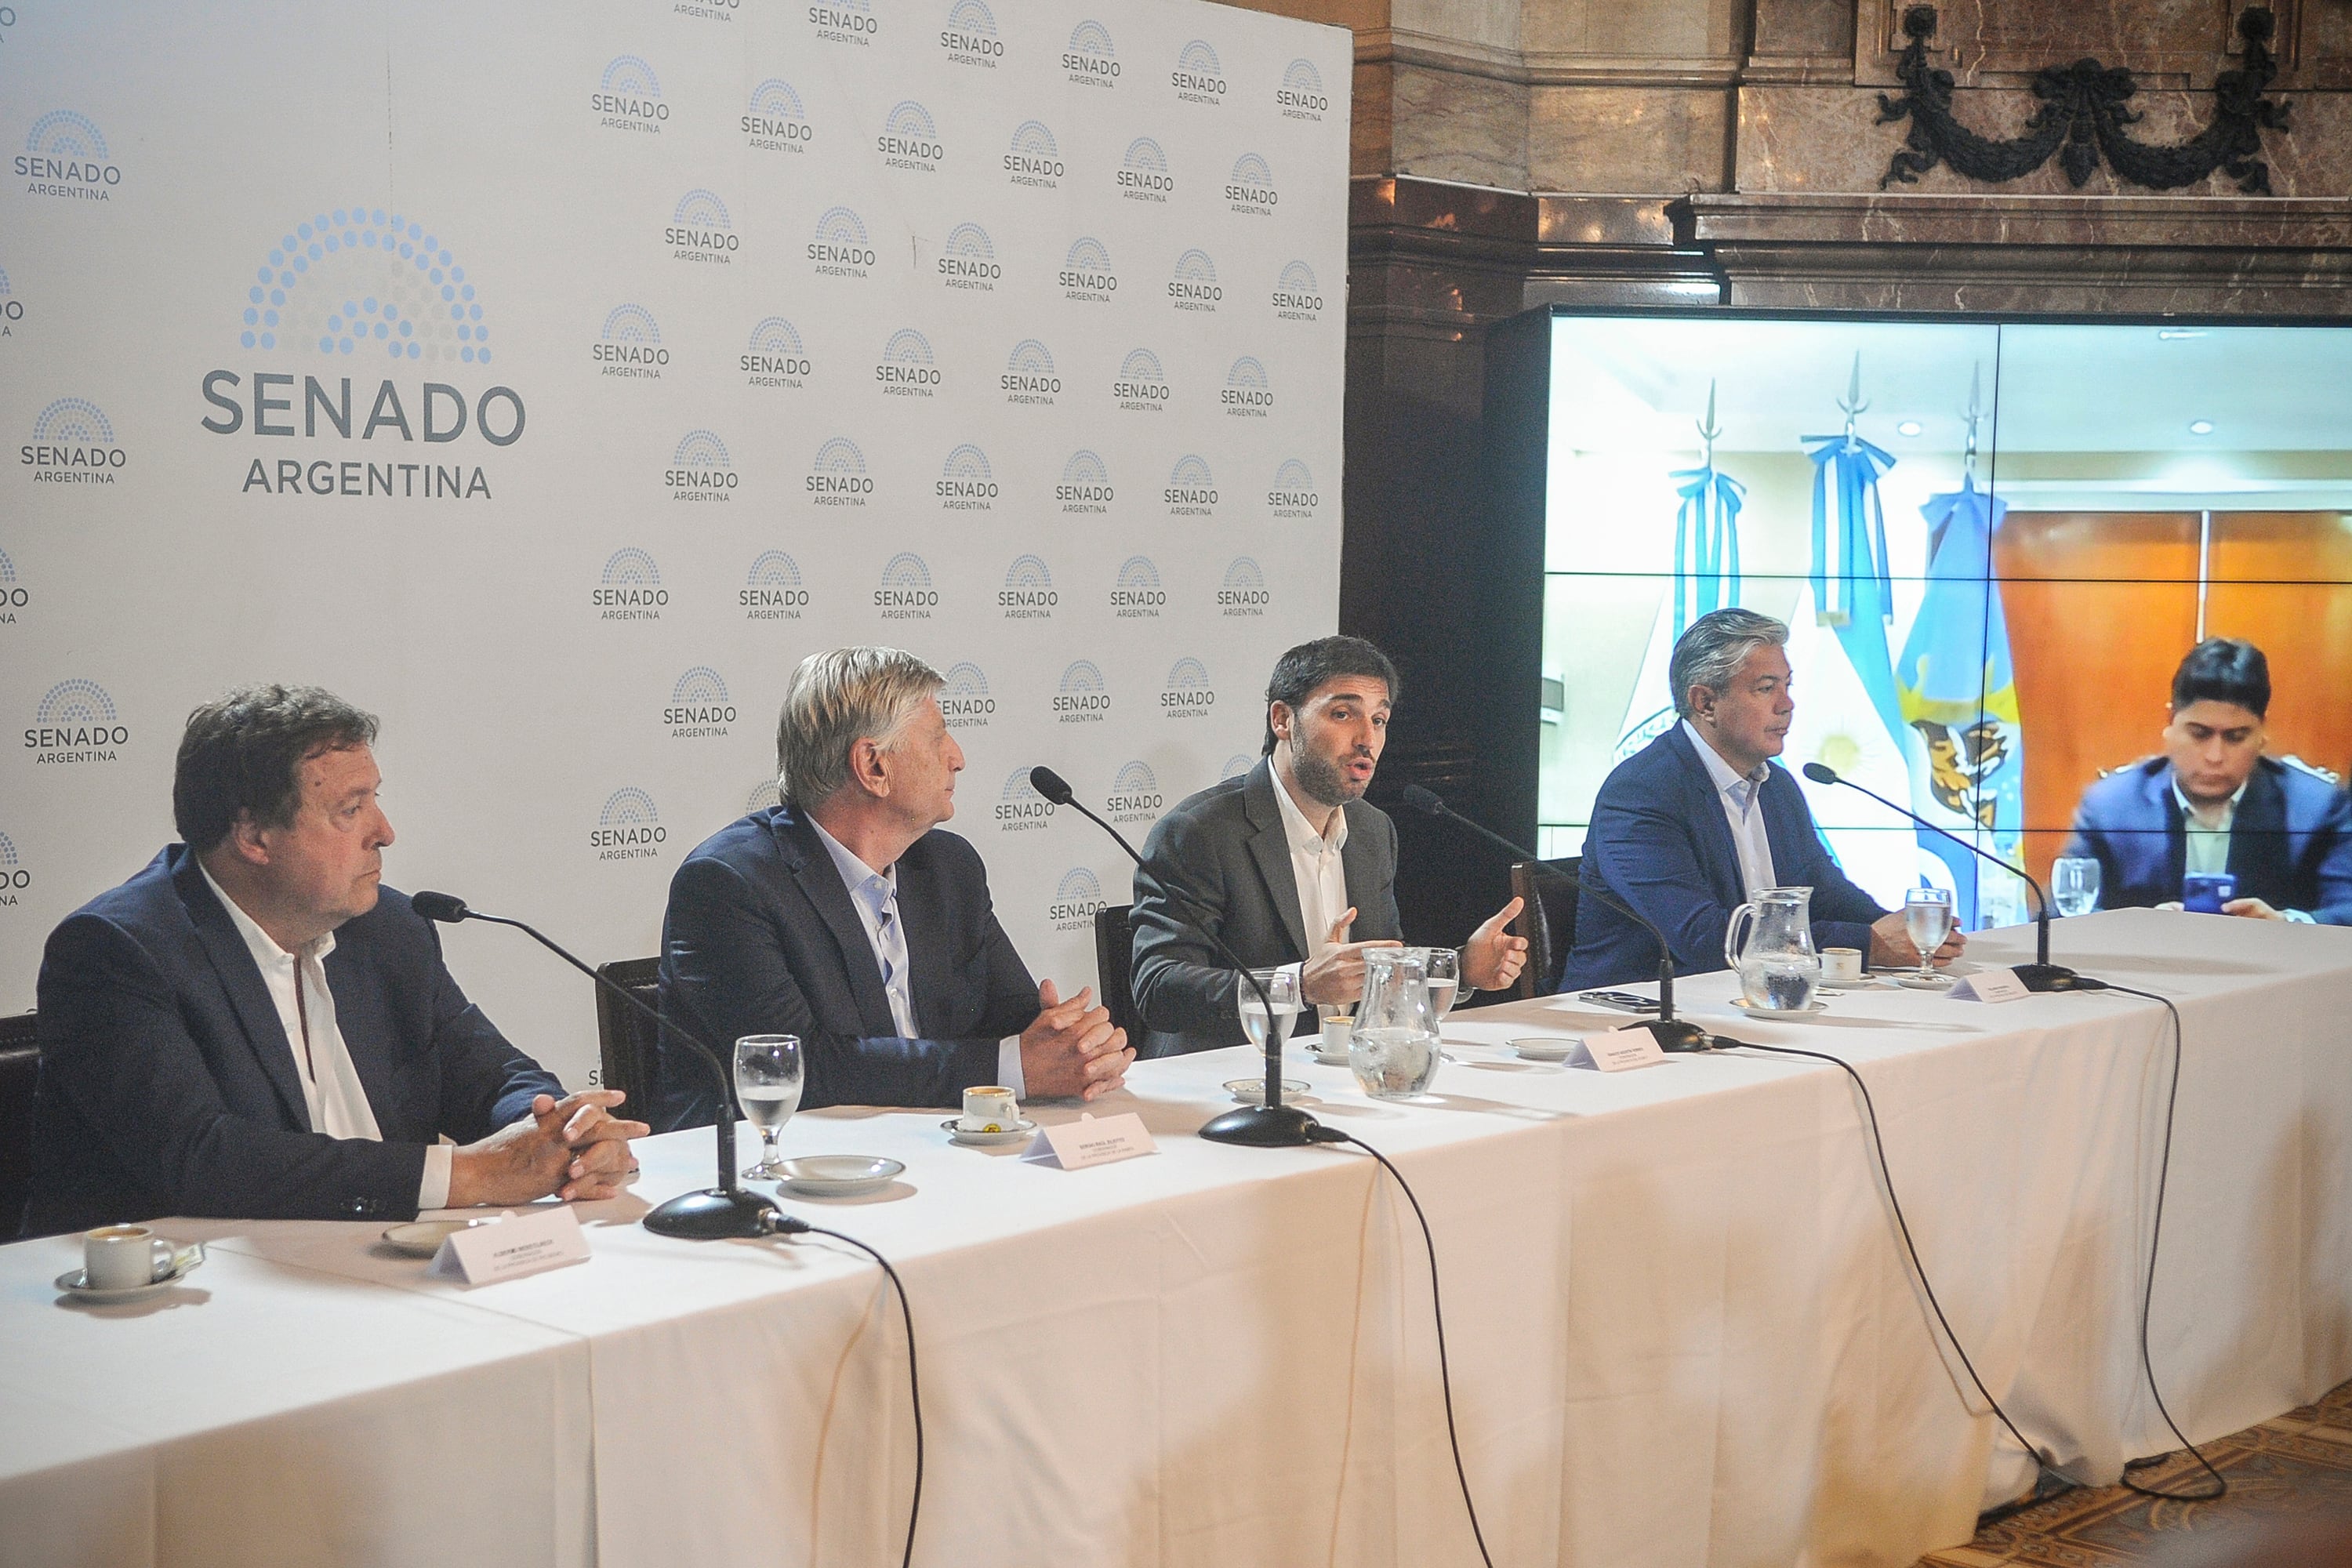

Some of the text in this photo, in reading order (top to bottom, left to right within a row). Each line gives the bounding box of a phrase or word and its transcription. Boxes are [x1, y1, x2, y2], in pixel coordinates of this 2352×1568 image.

[673, 3, 732, 23] ARGENTINA
[808, 6, 877, 34] SENADO
[816, 29, 869, 45] ARGENTINA
[940, 31, 1004, 56] SENADO
[947, 53, 996, 67] ARGENTINA
[1062, 53, 1120, 77] SENADO
[1069, 74, 1113, 87] ARGENTINA
[1171, 71, 1226, 94] SENADO
[1178, 92, 1219, 105] ARGENTINA
[1276, 89, 1327, 111] SENADO
[592, 93, 669, 120] SENADO
[1282, 109, 1321, 121] ARGENTINA
[601, 118, 659, 132] ARGENTINA
[741, 115, 811, 140] SENADO
[749, 138, 803, 152] ARGENTINA
[877, 136, 942, 160] SENADO
[14, 156, 120, 184] SENADO
[885, 158, 935, 171] ARGENTINA
[1004, 154, 1064, 176] SENADO
[1010, 175, 1056, 187] ARGENTINA
[1116, 170, 1173, 191] SENADO
[27, 183, 109, 201] ARGENTINA
[1123, 191, 1166, 201] ARGENTINA
[1225, 185, 1277, 205] SENADO
[1231, 204, 1271, 215] ARGENTINA
[665, 227, 739, 251] SENADO
[673, 250, 730, 263] ARGENTINA
[807, 243, 875, 266] SENADO
[815, 265, 866, 277] ARGENTINA
[938, 258, 1000, 279] SENADO
[945, 278, 993, 290] ARGENTINA
[1058, 271, 1117, 290] SENADO
[1065, 291, 1109, 301] ARGENTINA
[1167, 281, 1221, 300] SENADO
[1174, 301, 1215, 311] ARGENTINA
[1272, 292, 1323, 310] SENADO
[1277, 310, 1316, 321] ARGENTINA
[593, 343, 669, 365] SENADO
[601, 366, 660, 378] ARGENTINA
[740, 354, 811, 375] SENADO
[748, 376, 802, 388] ARGENTINA
[876, 365, 941, 384] SENADO
[883, 386, 933, 396] ARGENTINA
[1000, 374, 1061, 393] SENADO
[1113, 382, 1169, 400] SENADO
[1007, 394, 1054, 405] ARGENTINA
[1221, 389, 1273, 406] SENADO
[201, 369, 526, 447] SENADO
[1120, 401, 1162, 411] ARGENTINA
[1227, 408, 1266, 416] ARGENTINA
[20, 445, 125, 467] SENADO
[33, 470, 114, 483] ARGENTINA
[241, 458, 492, 500] ARGENTINA
[665, 470, 738, 488] SENADO
[806, 475, 873, 493] SENADO
[673, 491, 729, 501] ARGENTINA
[935, 481, 998, 498] SENADO
[1055, 485, 1113, 501] SENADO
[1163, 488, 1218, 504] SENADO
[813, 495, 865, 506] ARGENTINA
[942, 500, 990, 510] ARGENTINA
[1268, 492, 1318, 506] SENADO
[1062, 504, 1106, 513] ARGENTINA
[1170, 506, 1211, 515] ARGENTINA
[592, 589, 668, 605] SENADO
[739, 590, 809, 605] SENADO
[873, 590, 938, 606] SENADO
[998, 591, 1058, 606] SENADO
[1110, 590, 1166, 605] SENADO
[1217, 590, 1269, 604] SENADO
[601, 610, 659, 619] ARGENTINA
[746, 610, 800, 619] ARGENTINA
[881, 610, 931, 619] ARGENTINA
[1004, 609, 1051, 618] ARGENTINA
[1116, 608, 1159, 617] ARGENTINA
[1052, 695, 1110, 711] SENADO
[1160, 691, 1214, 706] SENADO
[663, 706, 736, 724] SENADO
[936, 699, 996, 717] ENADO
[1167, 709, 1207, 717] ARGENTINA
[946, 717, 989, 728] RGENTINA
[1059, 713, 1103, 722] ARGENTINA
[24, 726, 128, 748] SENADO
[671, 727, 728, 737] ARGENTINA
[36, 750, 117, 764] ARGENTINA
[1106, 793, 1162, 811] SENADO
[995, 802, 1055, 820] SENADO
[1113, 813, 1155, 822] ARGENTINA
[1002, 821, 1048, 831] ARGENTINA
[590, 826, 666, 847] SENADO
[599, 848, 657, 860] ARGENTINA
[1056, 920, 1095, 931] ARGENTIN
